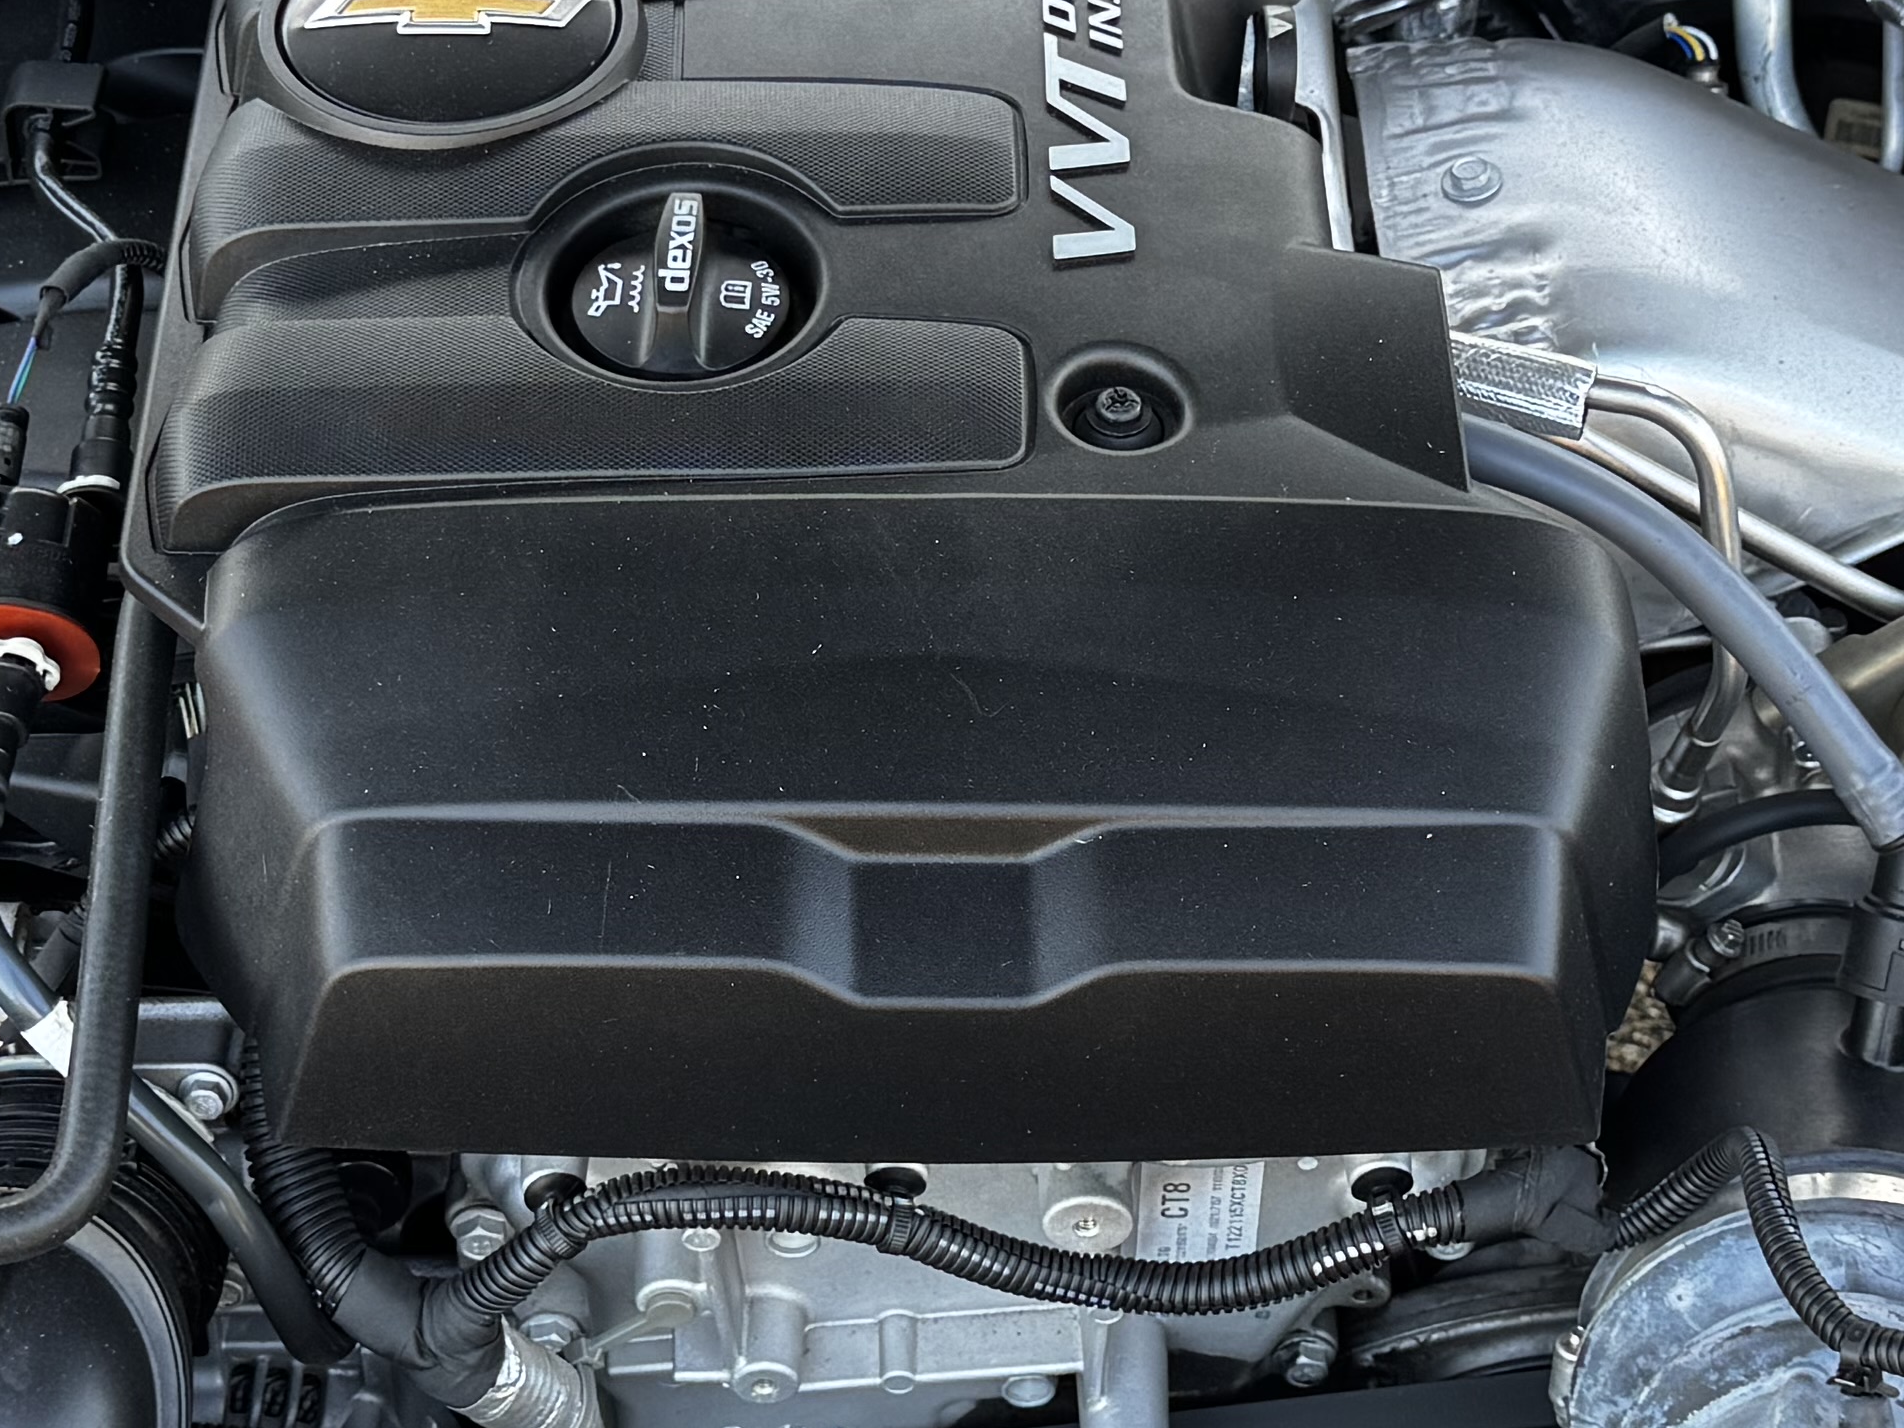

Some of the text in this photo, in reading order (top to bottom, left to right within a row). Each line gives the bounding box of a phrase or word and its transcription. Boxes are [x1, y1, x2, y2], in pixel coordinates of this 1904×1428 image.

[1043, 32, 1137, 260] VVT
[658, 198, 699, 292] dexos
[744, 259, 781, 339] SAE 5W-30
[1160, 1182, 1191, 1219] CT8
